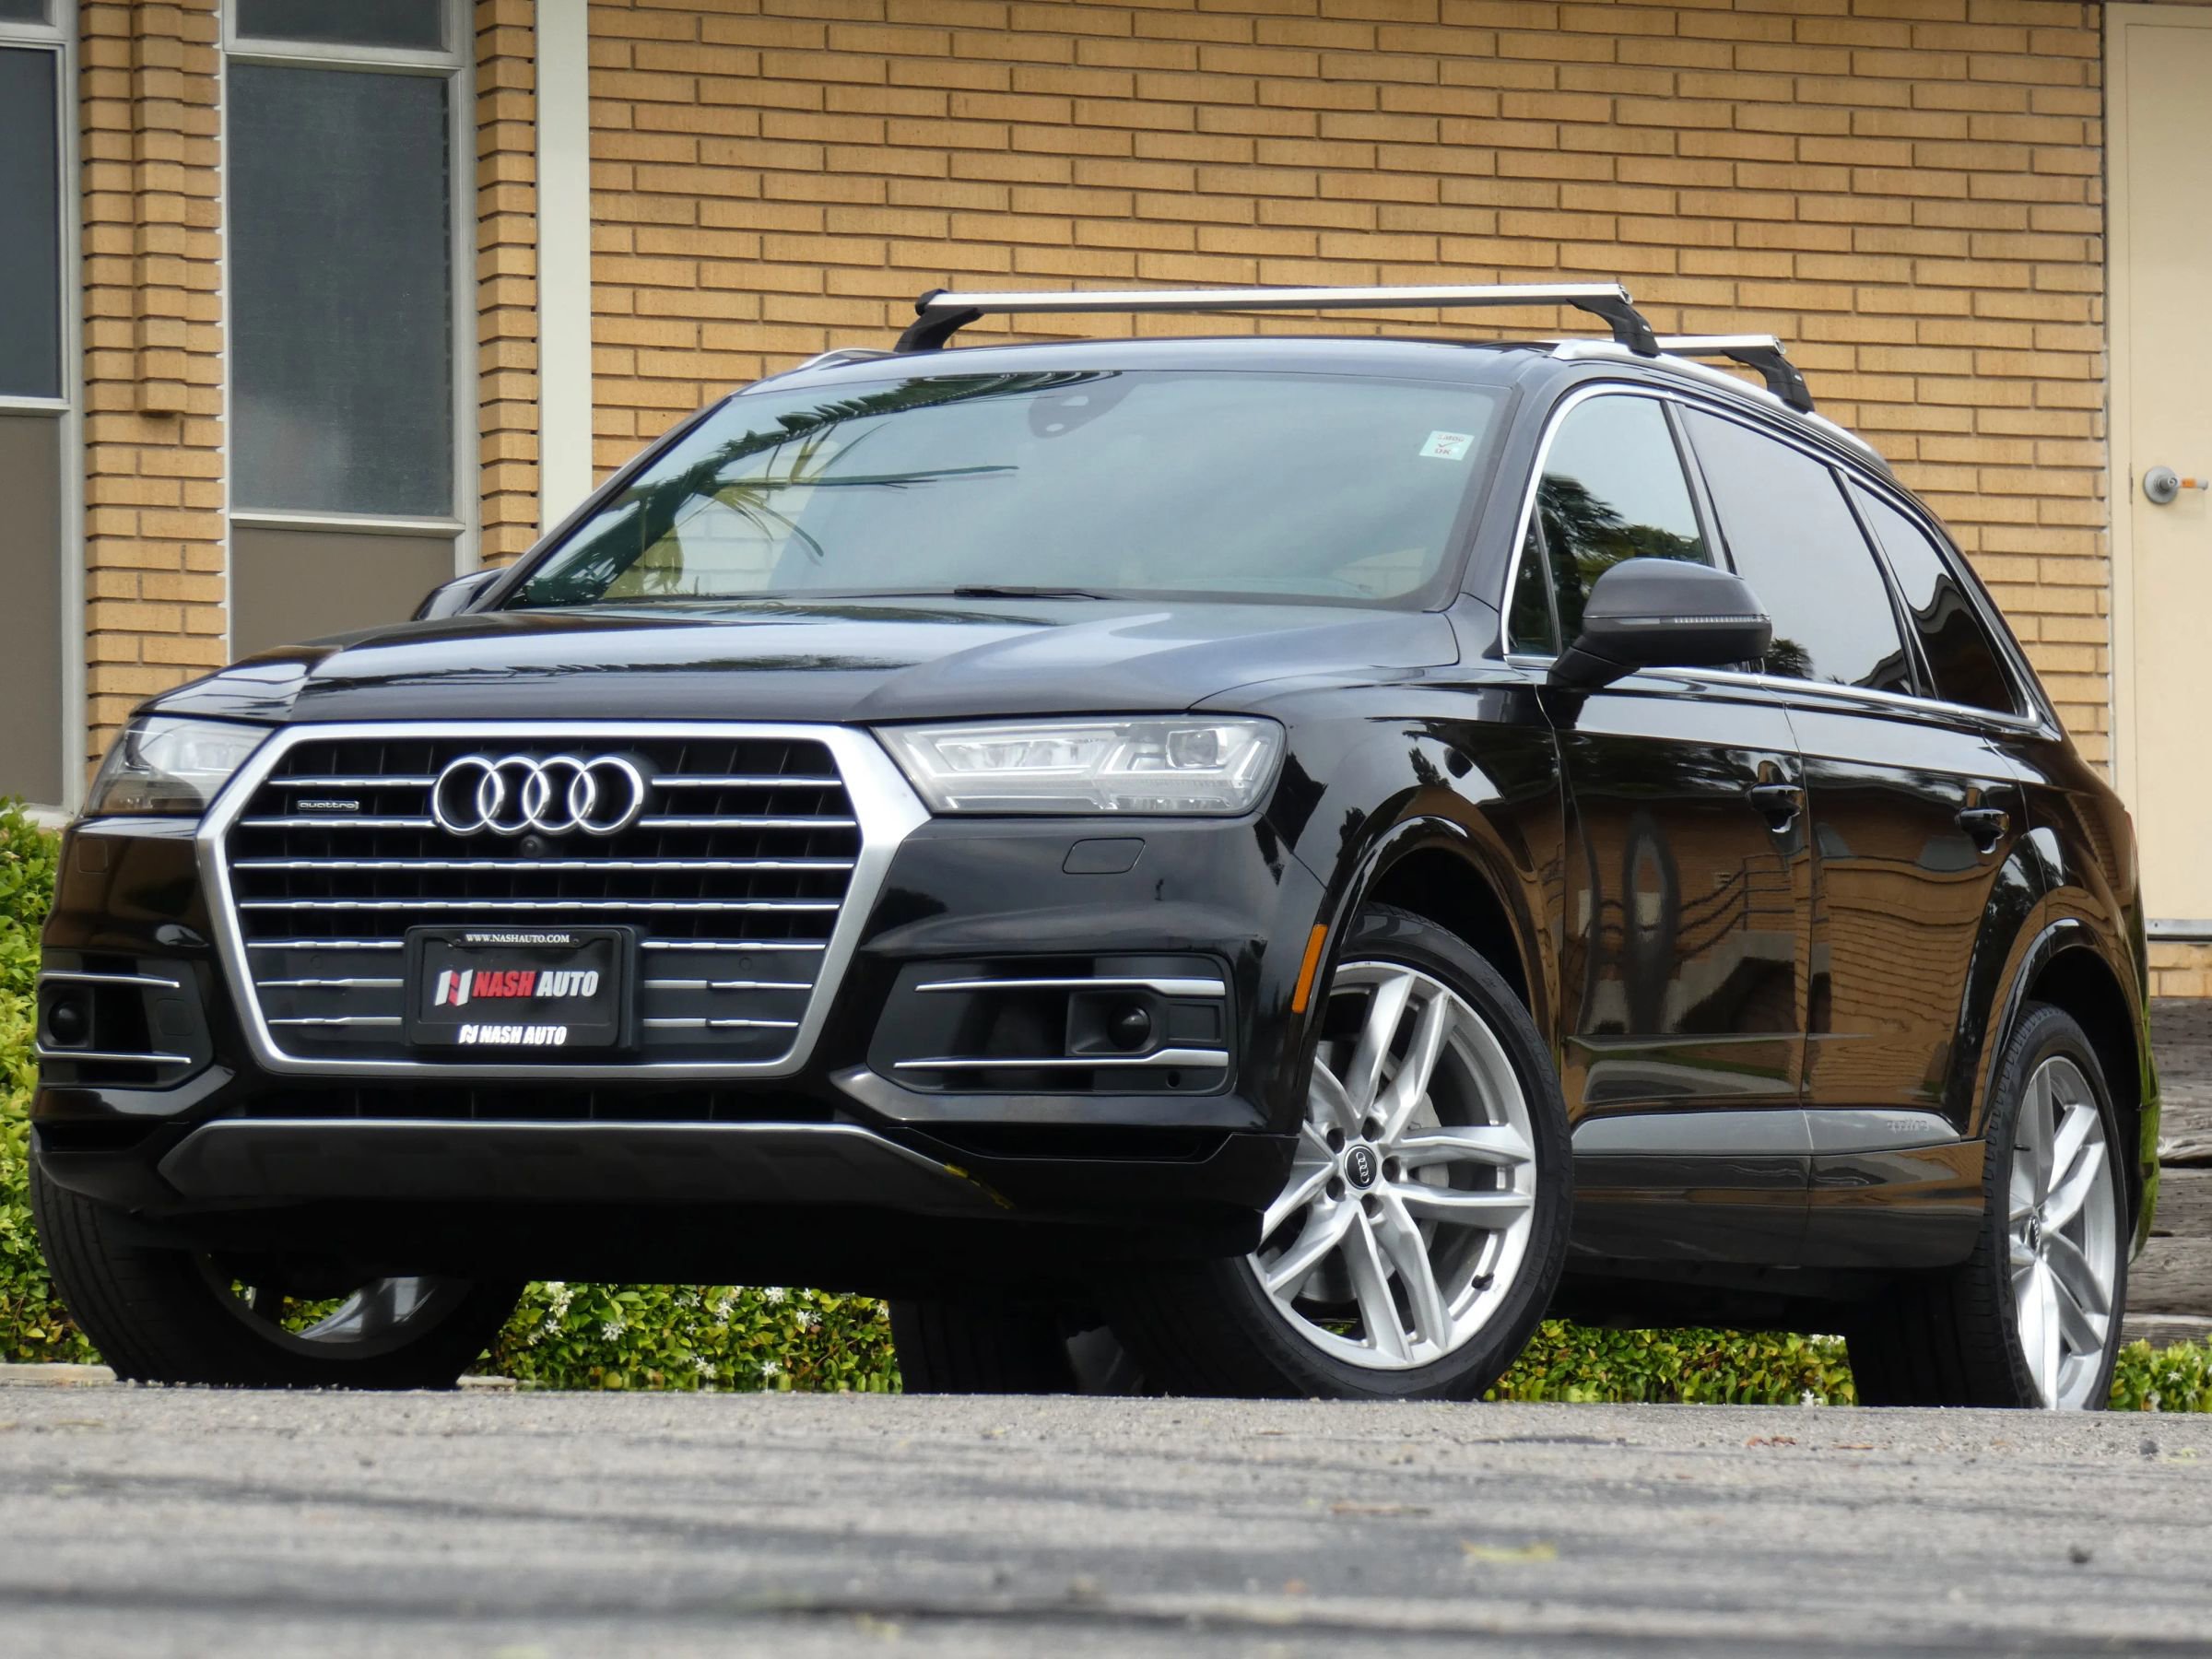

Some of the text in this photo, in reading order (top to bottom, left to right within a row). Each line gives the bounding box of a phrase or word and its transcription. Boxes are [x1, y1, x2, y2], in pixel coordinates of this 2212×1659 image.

[465, 934, 571, 944] WWW.NASHAUTO.COM
[472, 971, 537, 997] NASH
[536, 971, 599, 997] AUTO
[478, 1025, 523, 1044] NASH
[523, 1026, 568, 1045] AUTO
